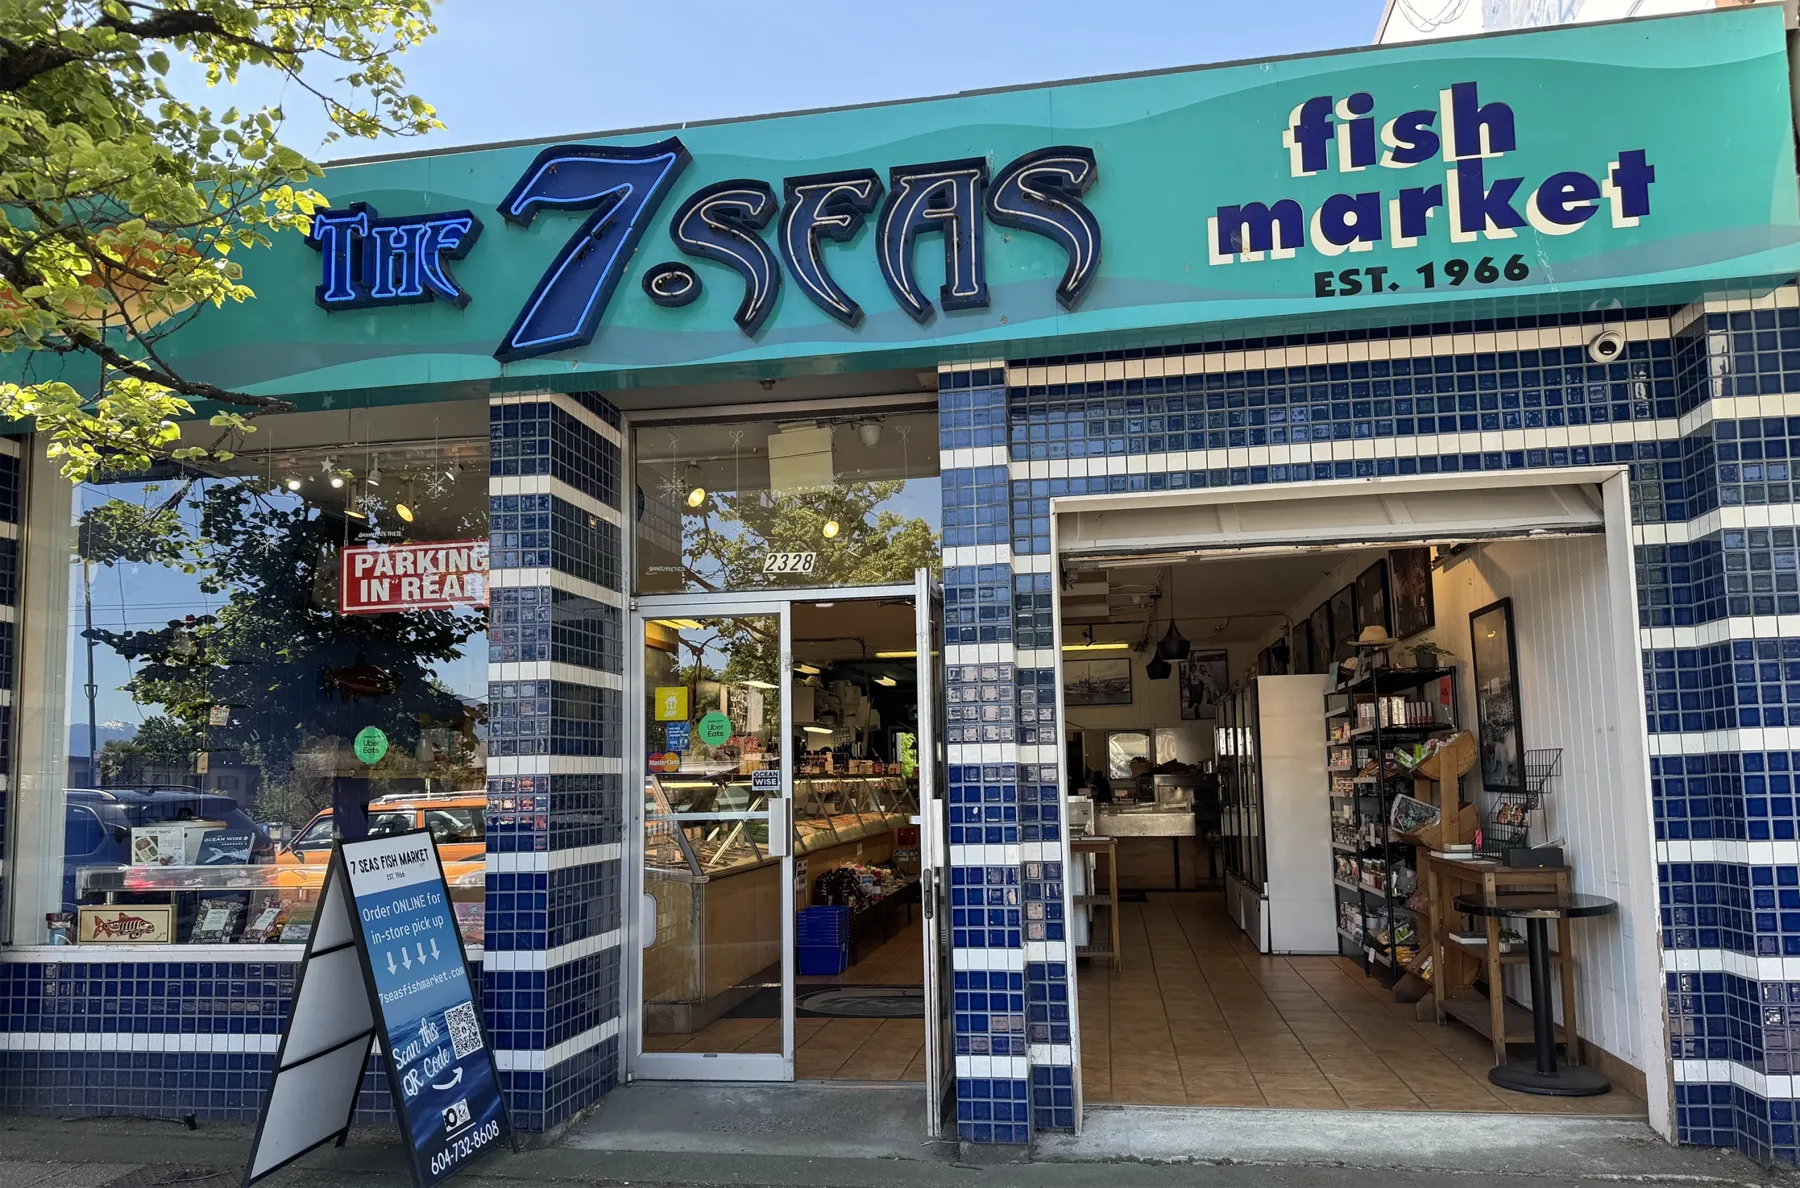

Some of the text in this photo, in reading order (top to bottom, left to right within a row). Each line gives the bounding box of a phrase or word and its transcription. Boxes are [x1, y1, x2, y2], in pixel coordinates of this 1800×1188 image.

[1283, 81, 1516, 177] fish
[1207, 149, 1655, 265] market
[304, 201, 484, 312] THE
[1314, 254, 1529, 298] EST. 1966
[355, 548, 489, 578] PARKING
[765, 553, 814, 572] 2328
[360, 578, 390, 603] IN
[754, 778, 777, 786] WISE
[350, 848, 429, 875] 7 SEAS FISH MARKET
[362, 892, 441, 922] Order ONLINE for
[371, 915, 444, 945] in-store pick up
[392, 1017, 440, 1070] Scan this
[403, 1046, 451, 1096] QR Code
[431, 1120, 499, 1175] 604-732-8608
